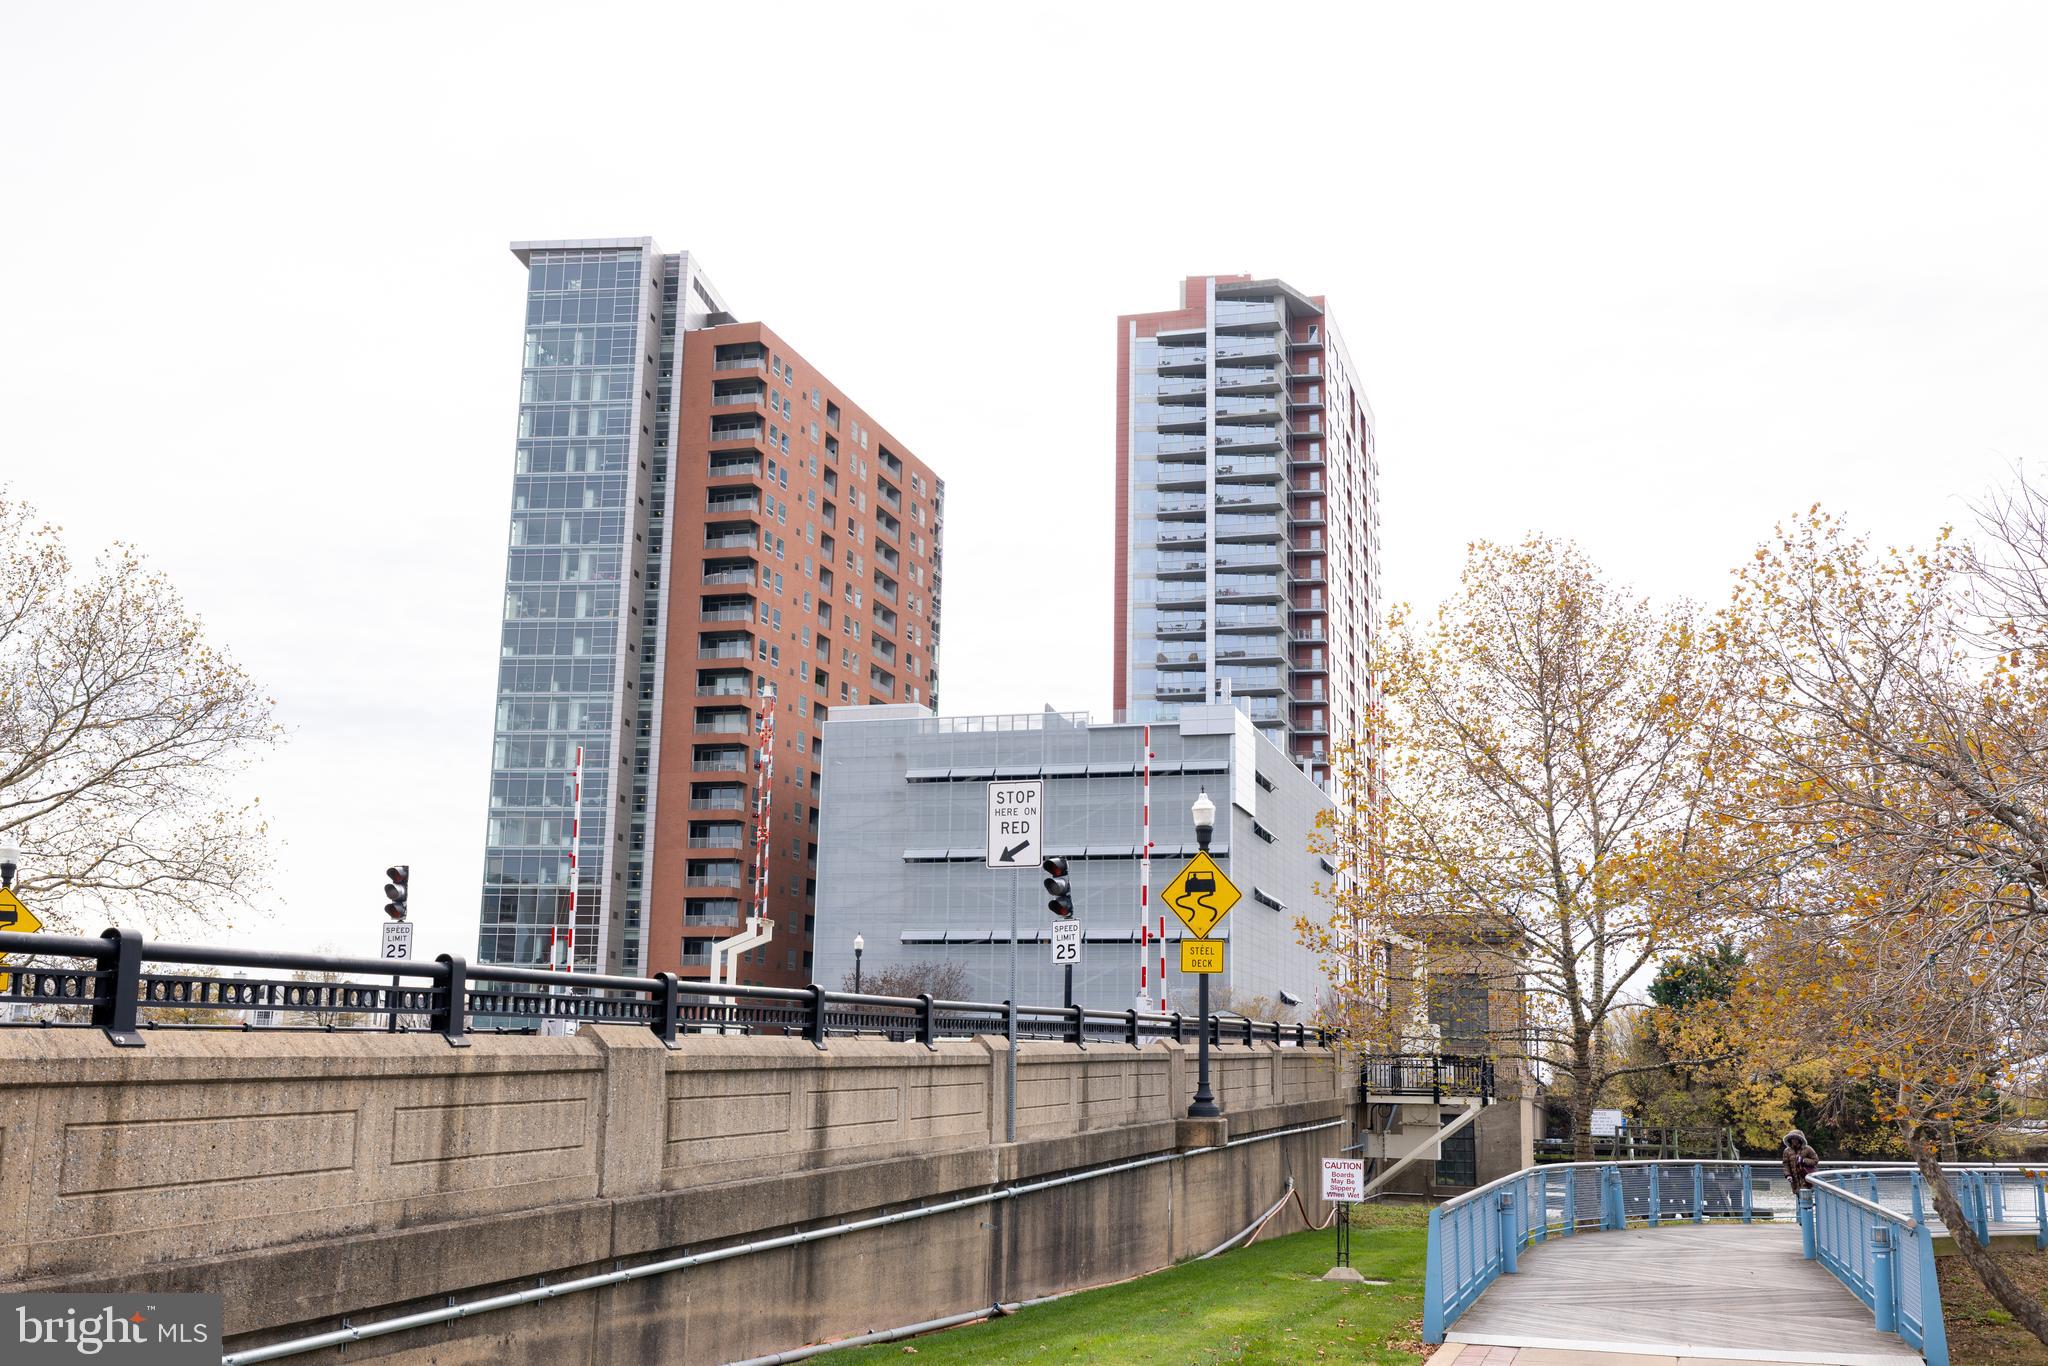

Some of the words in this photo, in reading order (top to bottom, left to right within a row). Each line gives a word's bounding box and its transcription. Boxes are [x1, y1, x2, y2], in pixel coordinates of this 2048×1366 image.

[996, 790, 1035, 804] STOP
[995, 807, 1018, 816] HERE
[1024, 807, 1037, 815] ON
[1001, 821, 1030, 834] RED
[1054, 924, 1078, 932] SPEED
[1056, 933, 1076, 941] LIMIT
[386, 944, 407, 958] 25
[1056, 943, 1077, 960] 25
[1190, 946, 1215, 955] STEEL
[1191, 959, 1213, 967] DECK
[1324, 1161, 1362, 1170] CAUTION
[1331, 1171, 1355, 1179] Boards
[1330, 1184, 1356, 1192] Slippery
